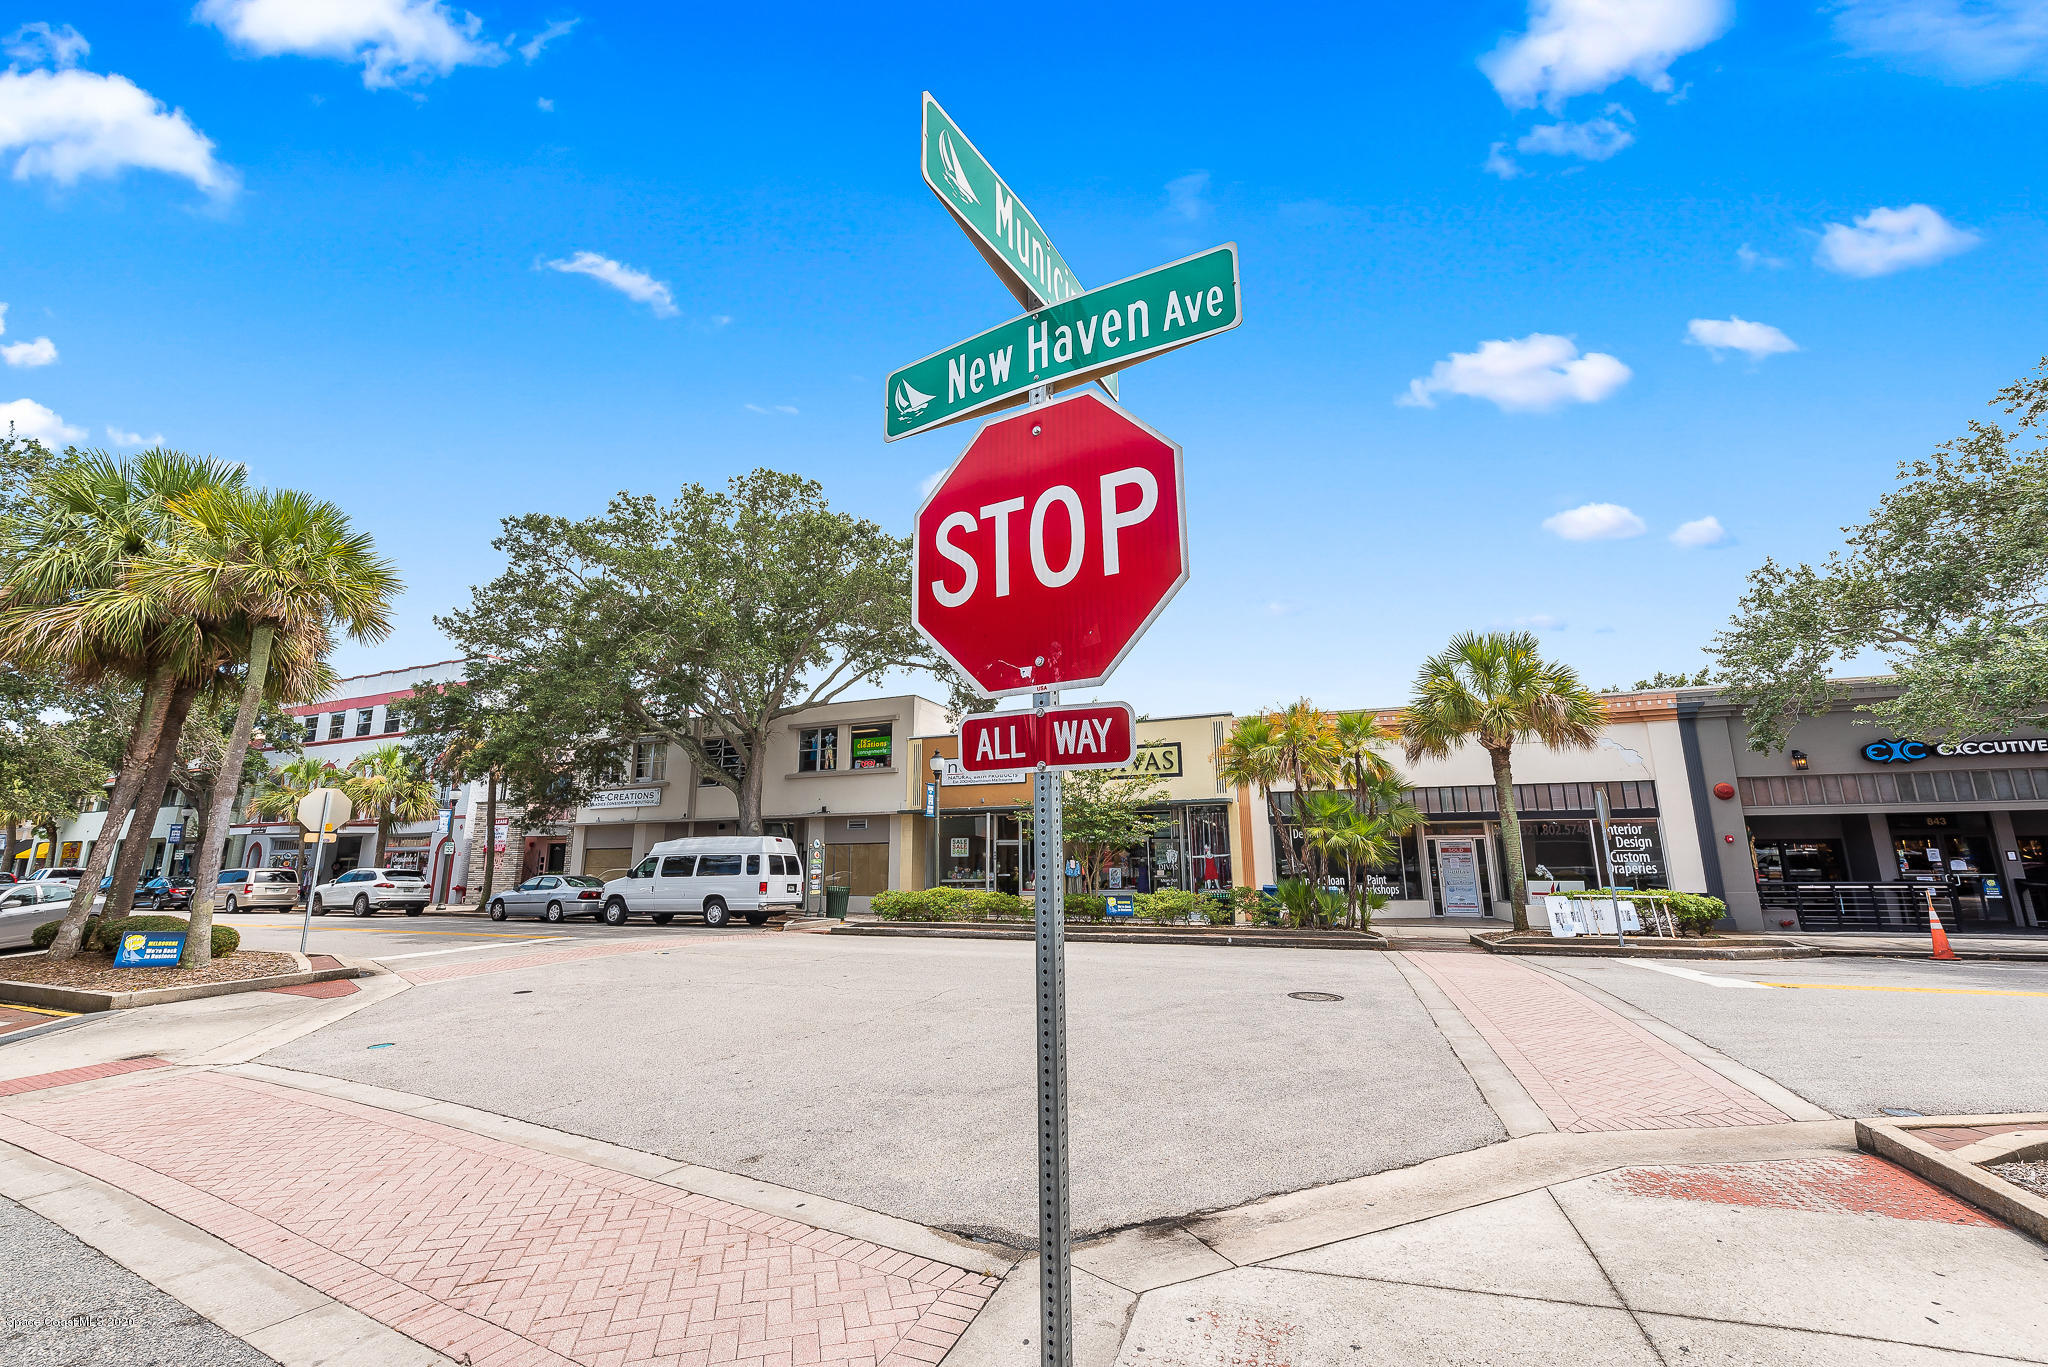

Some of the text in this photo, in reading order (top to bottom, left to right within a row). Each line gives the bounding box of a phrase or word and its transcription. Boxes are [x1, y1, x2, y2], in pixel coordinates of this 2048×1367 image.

[995, 181, 1077, 300] Munici
[948, 285, 1224, 404] New Haven Ave
[931, 466, 1159, 608] STOP
[976, 717, 1113, 762] ALL WAY
[1607, 823, 1643, 836] nterior
[1615, 836, 1653, 851] Design
[1610, 851, 1651, 863] Custom
[1158, 863, 1179, 871] DIVAS
[1366, 874, 1388, 885] Paint
